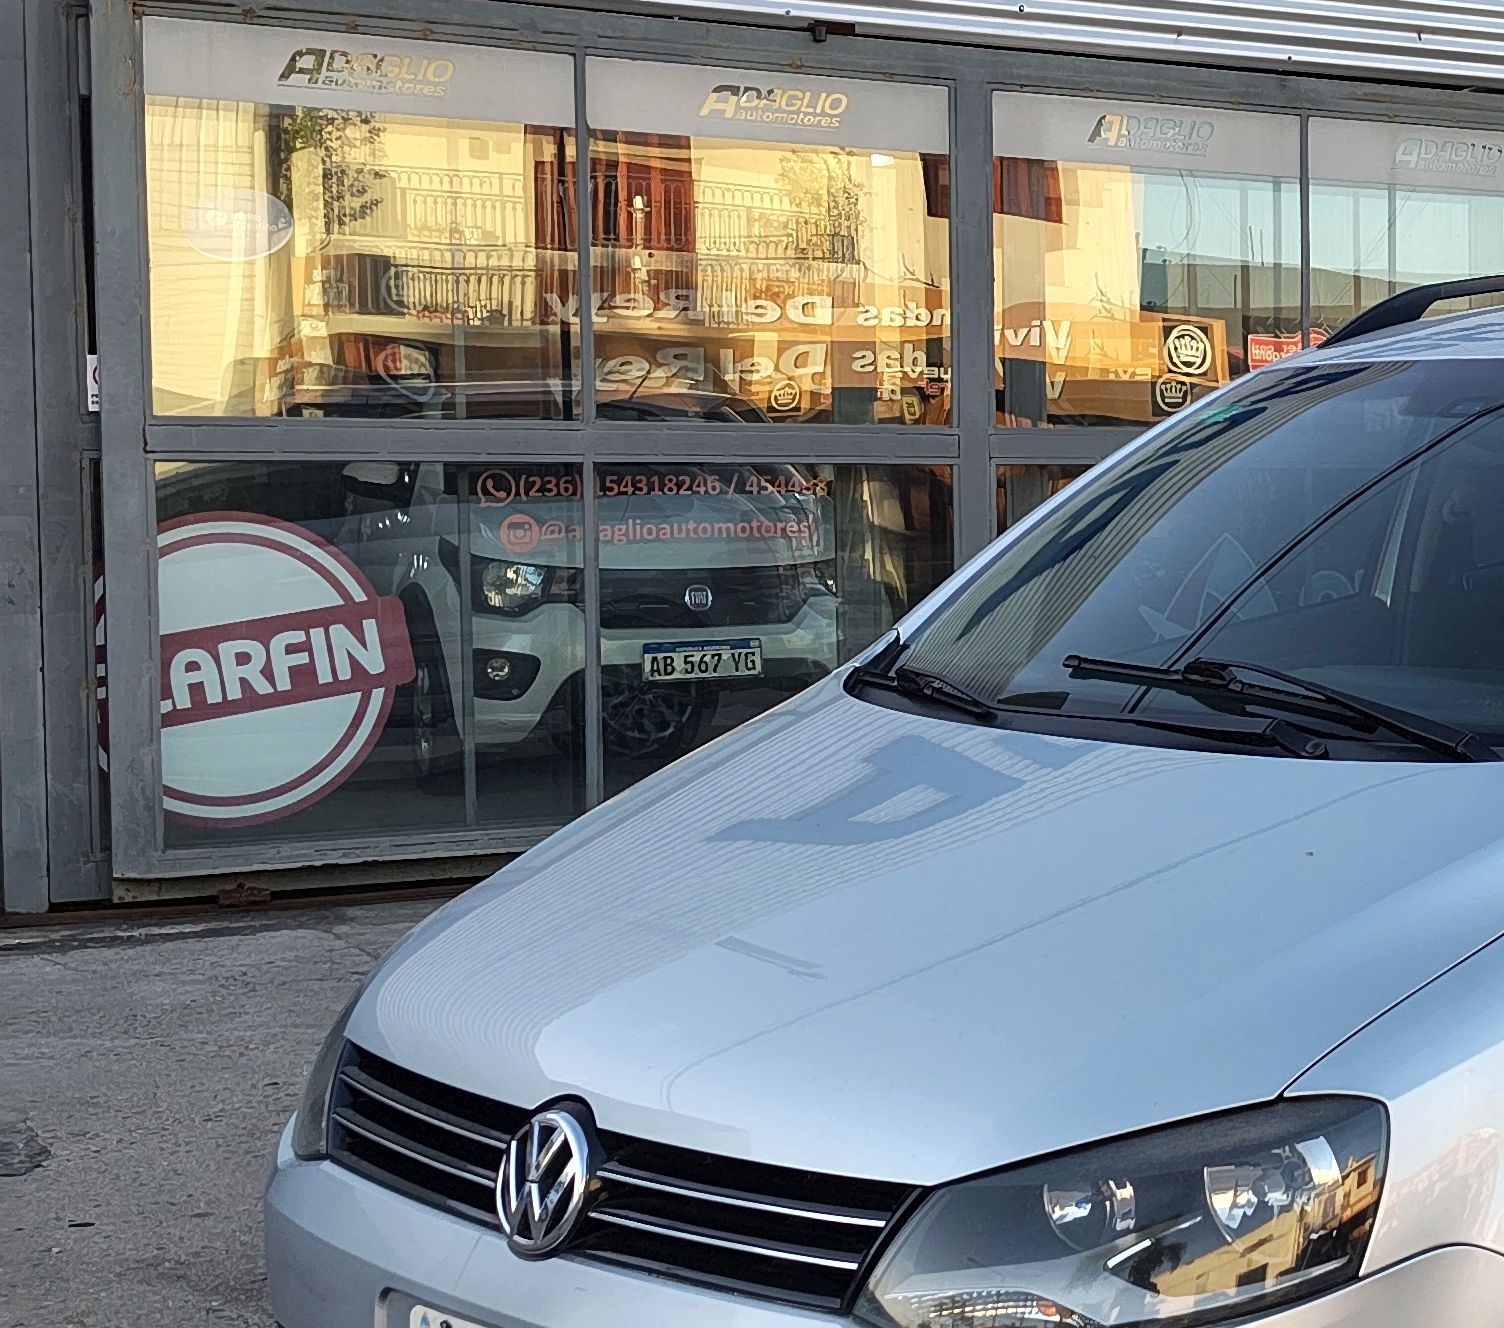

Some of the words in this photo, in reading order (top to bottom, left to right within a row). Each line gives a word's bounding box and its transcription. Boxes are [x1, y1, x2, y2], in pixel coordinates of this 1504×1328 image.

[278, 47, 456, 84] ADAGLIO
[699, 84, 848, 119] ADAGLIO
[735, 108, 841, 128] automotores
[1087, 114, 1215, 146] ADAGLIO
[519, 474, 582, 501] (236)
[541, 517, 810, 545] @aaglioautomotores
[650, 655, 675, 678] AB
[683, 652, 722, 675] 567
[731, 651, 757, 672] YG
